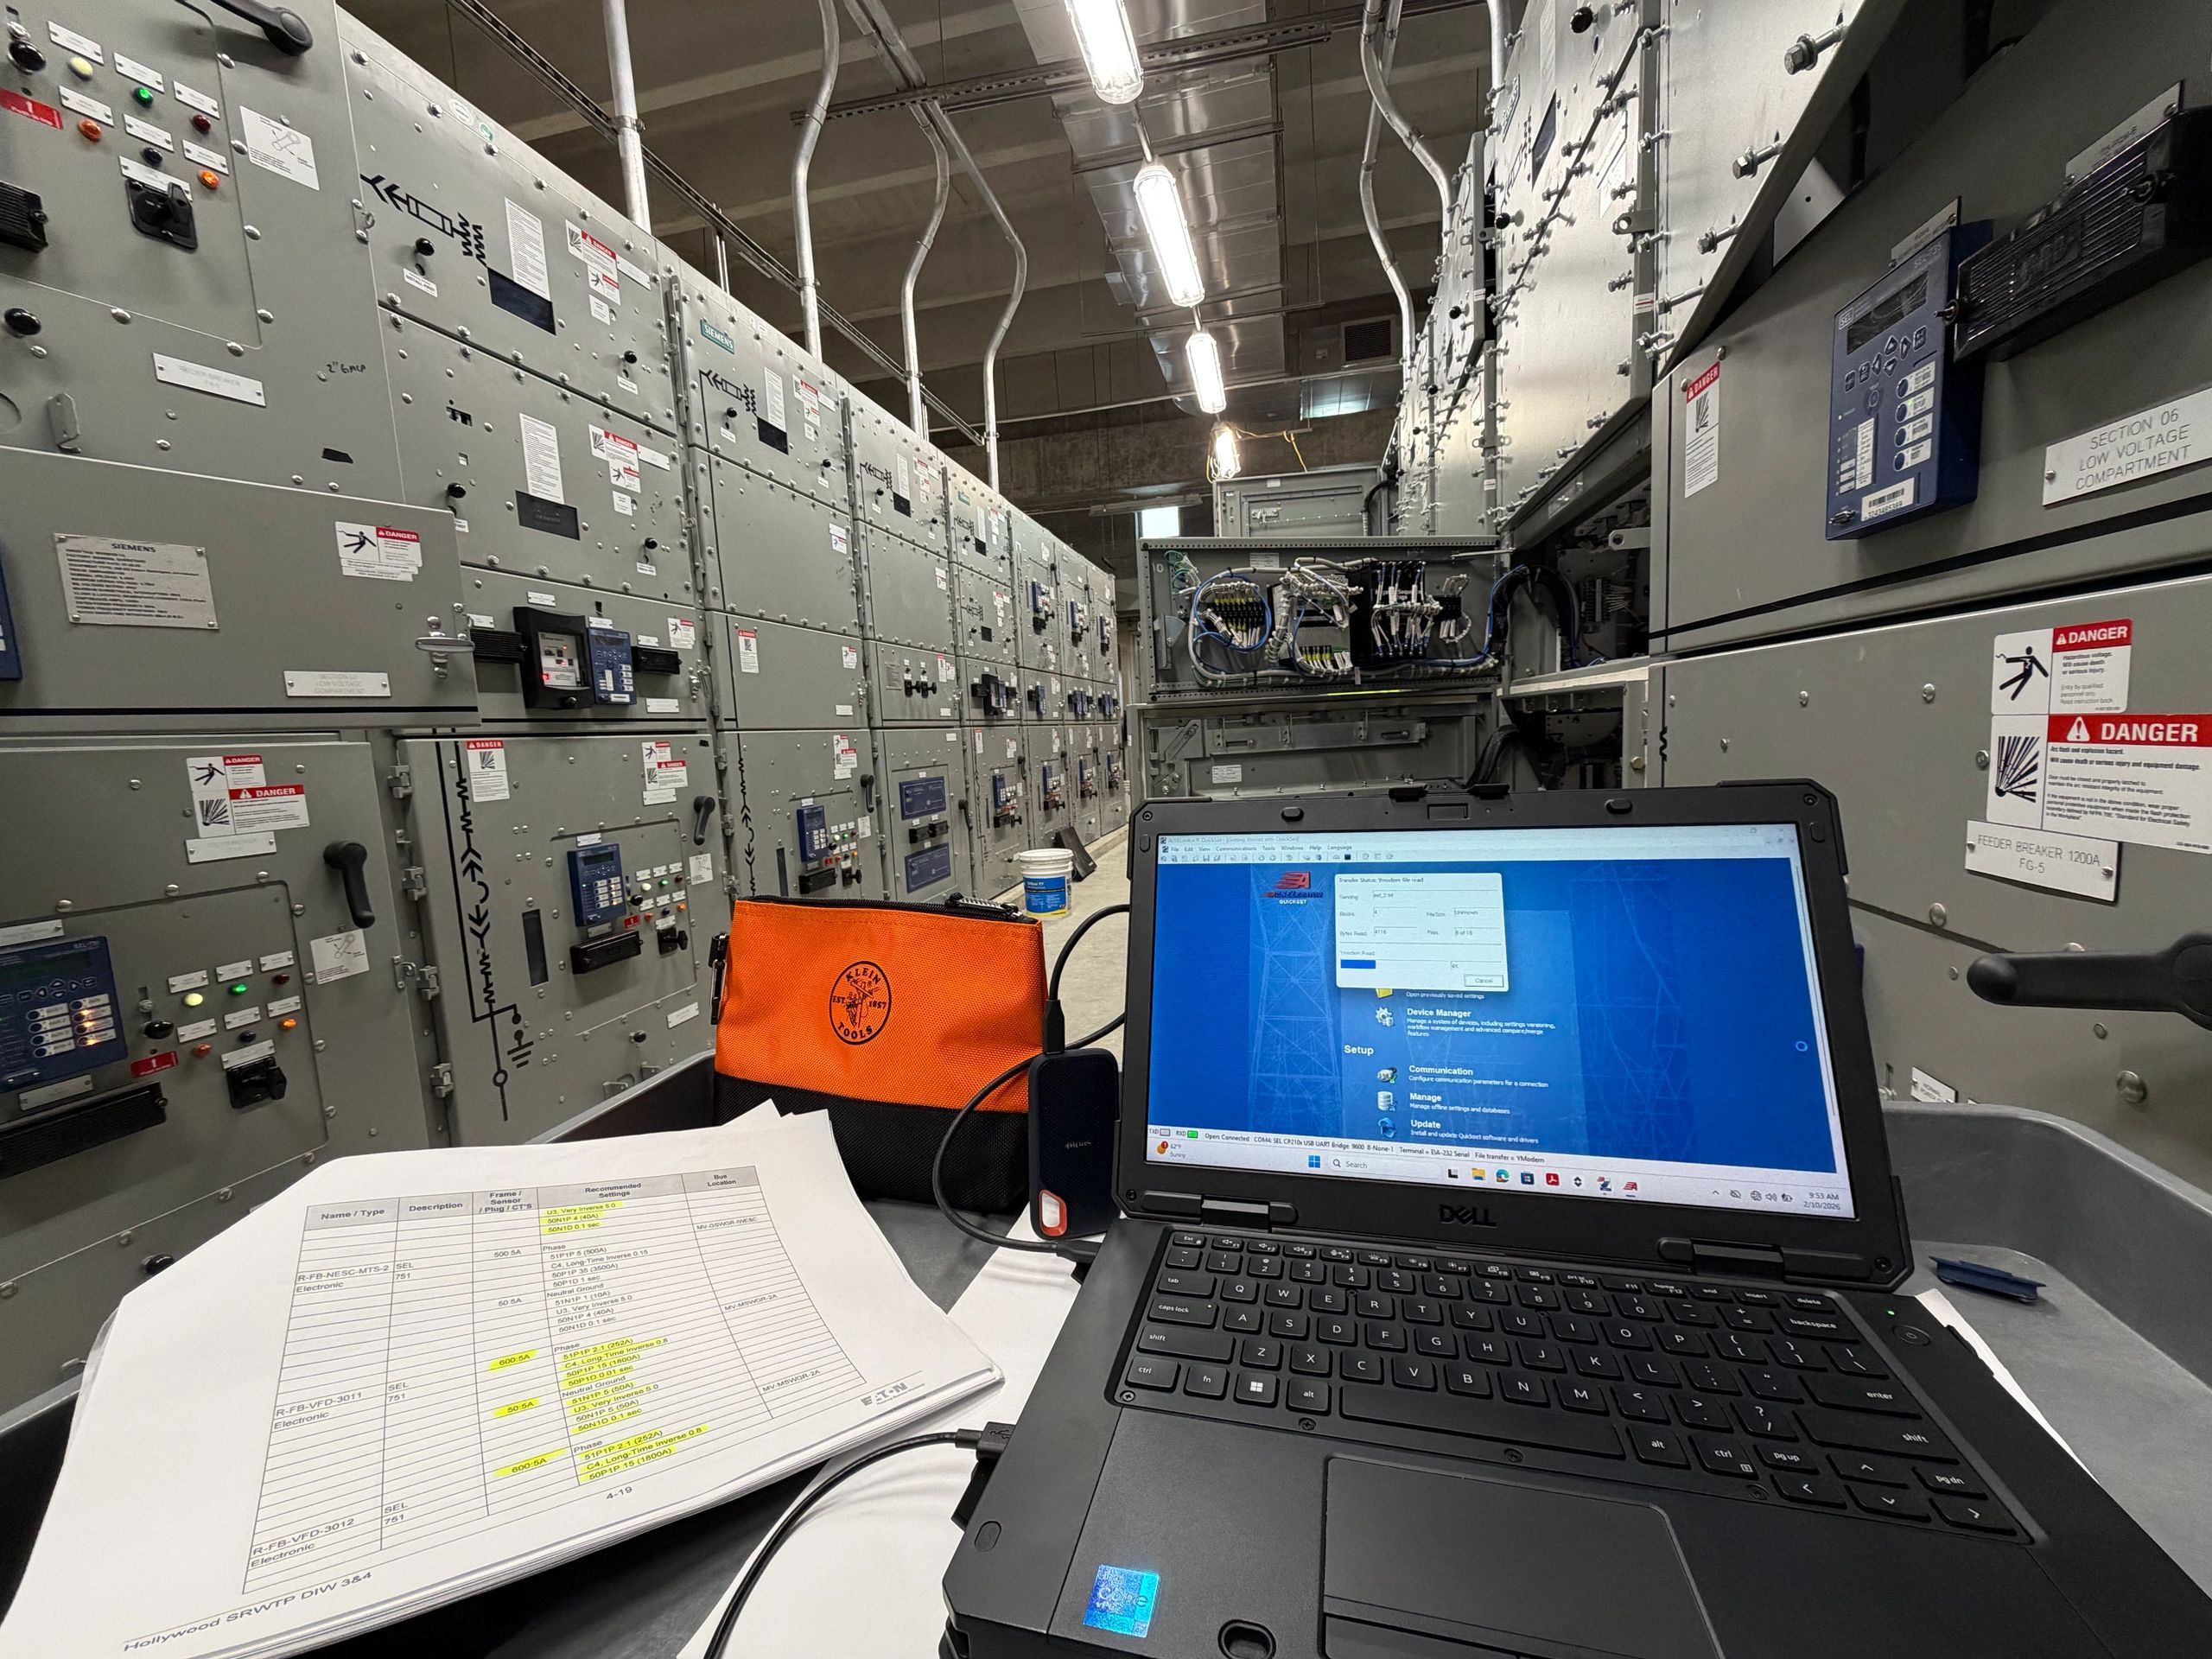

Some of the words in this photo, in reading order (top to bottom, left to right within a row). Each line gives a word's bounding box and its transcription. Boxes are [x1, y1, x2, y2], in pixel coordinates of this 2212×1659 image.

[703, 324, 733, 349] SIEMENS
[1694, 366, 1718, 393] DANGER
[2089, 416, 2153, 449] SECTION
[2161, 408, 2179, 425] 06
[2080, 451, 2110, 472] LOW
[2116, 423, 2191, 459] VOLTAGE
[2075, 444, 2192, 490] COMPARTMENT
[385, 531, 417, 540] DANGER
[111, 543, 156, 552] SIEMENS
[2069, 626, 2128, 644] DANGER
[2101, 722, 2198, 742] DANGER
[256, 788, 296, 797] DANGER
[1977, 834, 2012, 849] FEEDER
[2016, 842, 2063, 859] BREAKER
[2068, 850, 2101, 866] 1200A
[2019, 858, 2044, 873] FG-5
[846, 968, 880, 984] KLEIN
[868, 1001, 887, 1009] 1857
[1436, 1009, 1471, 1018] Manager
[838, 1021, 872, 1039] TOOLS
[1344, 1045, 1374, 1056] Setup
[1409, 1065, 1473, 1076] Communication
[1409, 1093, 1441, 1103] Manage
[1411, 1120, 1440, 1129] Update
[1221, 1133, 1249, 1142] Connected
[1346, 1160, 1367, 1169] Search
[585, 1183, 641, 1193] Recommended
[707, 1179, 736, 1187] Location
[599, 1191, 631, 1199] Settings
[409, 1202, 463, 1212] Description
[1804, 1201, 1840, 1210] 2/10/2026
[321, 1211, 352, 1220] Name
[359, 1208, 385, 1217] Type
[1439, 1204, 1497, 1228] DELL
[543, 1243, 566, 1252] Phase
[396, 1262, 414, 1270] SEL
[298, 1265, 389, 1281] R-FB-NESC-MTS-2
[296, 1281, 344, 1294] Electronic
[547, 1287, 575, 1298] Neutral
[576, 1283, 603, 1294] Ground
[1789, 1317, 1837, 1331] backspace
[554, 1342, 580, 1352] Phase
[499, 1353, 531, 1366] 600:5A
[388, 1382, 409, 1391] SEL
[562, 1385, 593, 1398] Neutral
[594, 1376, 626, 1389] Ground
[762, 1369, 821, 1393] MV-MSWGR-2A
[388, 1393, 406, 1402] 751
[1866, 1390, 1892, 1401] enter
[276, 1392, 363, 1417] R-FB-VFD-3011
[507, 1401, 534, 1413] 50:5A
[274, 1411, 329, 1430] Electronic
[584, 1446, 616, 1460] 51P1P
[617, 1441, 632, 1450] 2.1
[634, 1430, 663, 1446] (252A)
[1651, 1439, 1665, 1450] alt
[1903, 1433, 1929, 1444] shift
[574, 1440, 602, 1453] Phase
[605, 1444, 653, 1465] Long-Time
[655, 1433, 687, 1450] Inverse
[689, 1427, 702, 1436] 0.8
[1714, 1448, 1732, 1459] ctrl
[512, 1458, 547, 1473] 600:5A
[589, 1465, 621, 1480] 50P1P
[624, 1459, 635, 1468] 15
[606, 1486, 632, 1500] 4-19
[385, 1503, 408, 1514] SEL
[384, 1514, 405, 1526] 751
[253, 1518, 355, 1555] R-FB-VFD-3012
[251, 1542, 315, 1568] Electronic
[124, 1618, 221, 1652] Hollywood
[226, 1595, 296, 1623] SRWTP
[301, 1582, 337, 1600] DIW
[341, 1572, 372, 1587] 3&4
